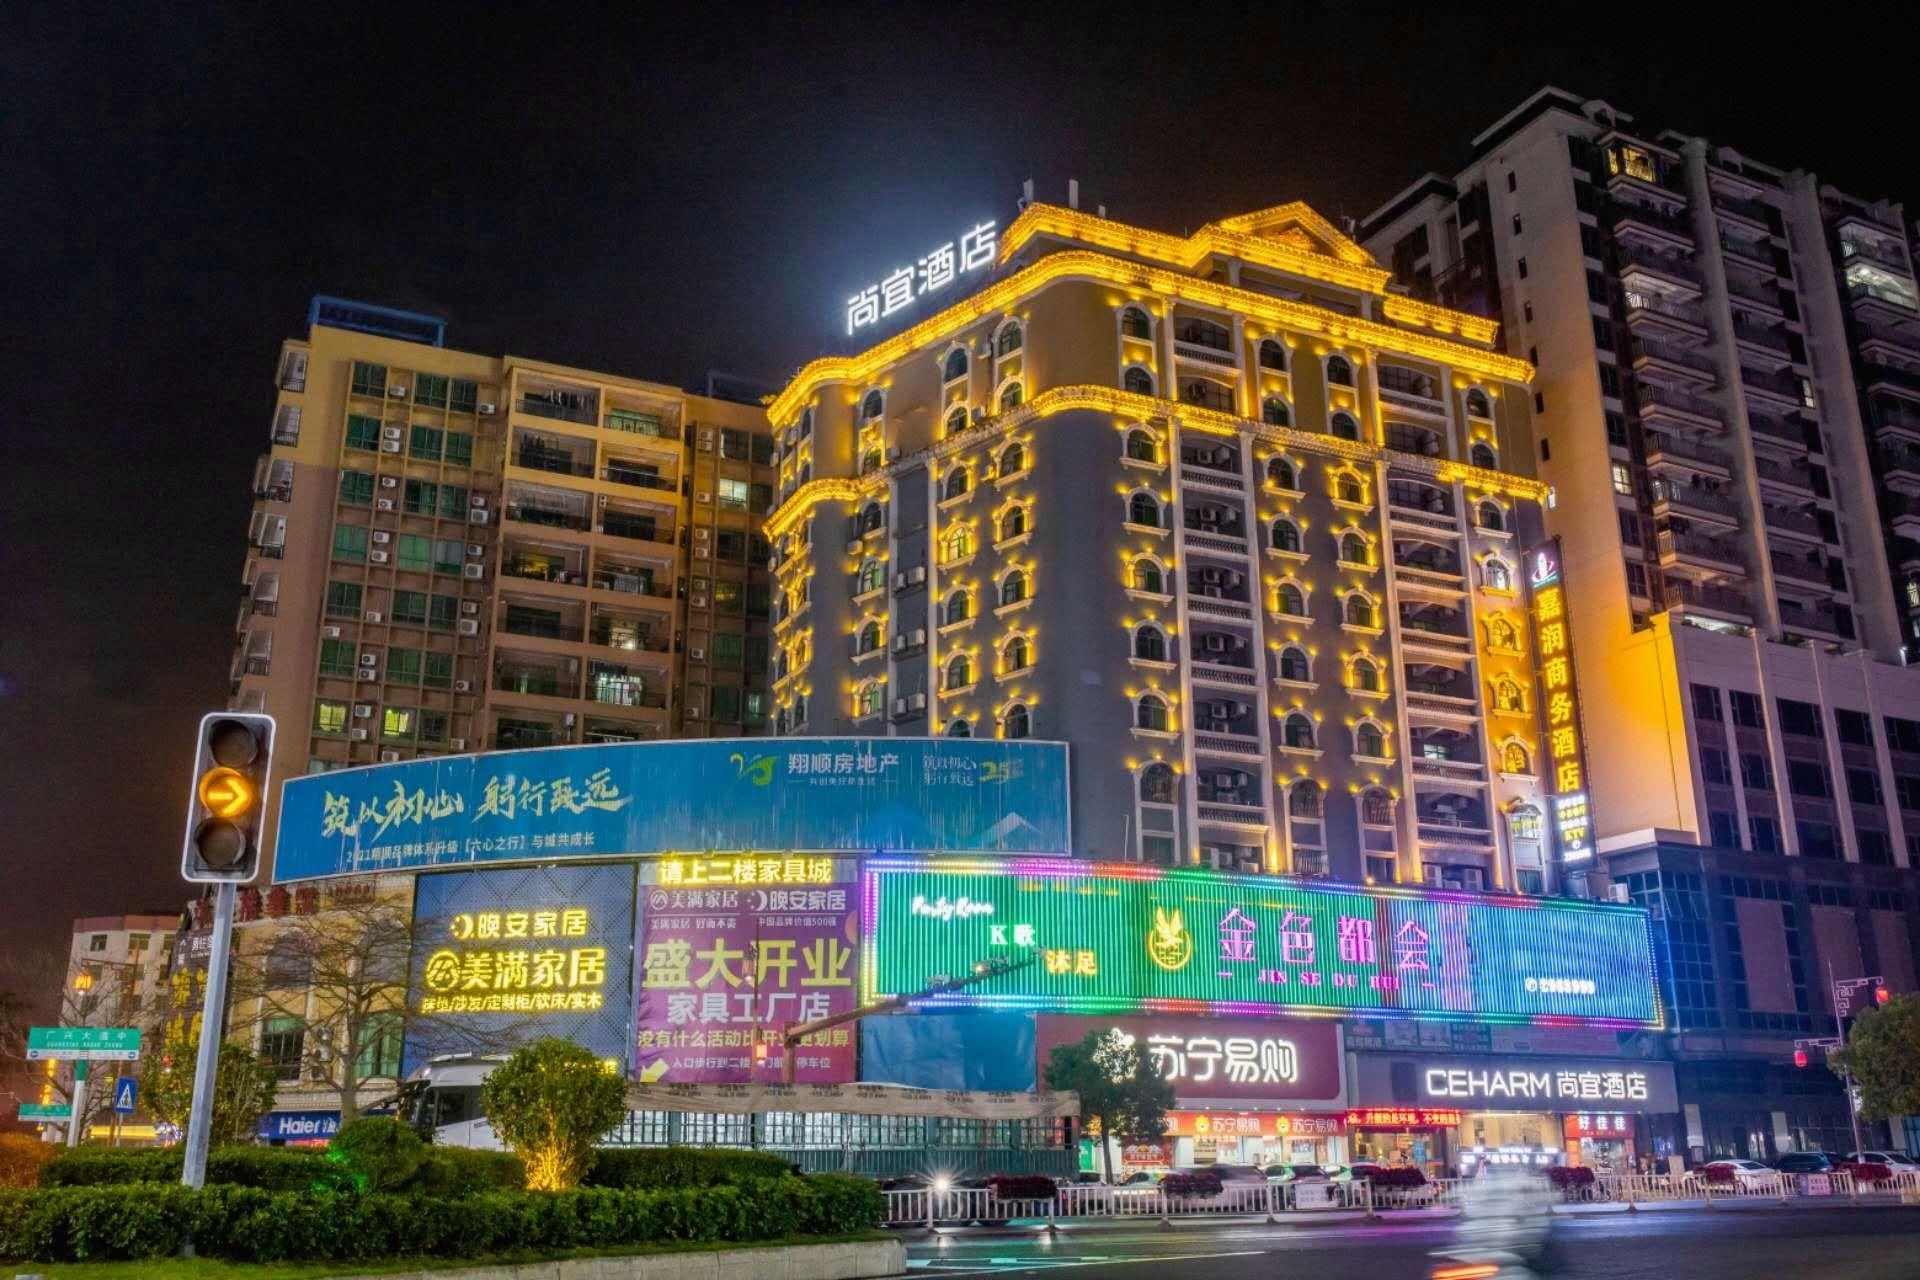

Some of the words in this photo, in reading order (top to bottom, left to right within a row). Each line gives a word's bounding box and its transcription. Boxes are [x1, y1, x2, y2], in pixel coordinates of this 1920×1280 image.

[847, 220, 996, 336] 尚宜酒店
[1535, 586, 1582, 794] 嘉润商务酒店
[787, 751, 900, 775] 翔顺房地产
[472, 767, 634, 825] 躬行致远
[659, 857, 833, 886] 请上二楼家具城
[670, 889, 739, 910] 美满家居
[769, 889, 847, 912] 晚安家居
[476, 909, 588, 940] 晚安家居
[1217, 907, 1430, 972] 金色都会
[460, 948, 607, 990] 美满家居
[640, 938, 852, 989] 盛大开业
[1045, 948, 1099, 976] 沐足
[1258, 969, 1287, 985] JIN
[1301, 971, 1322, 986] SE
[1333, 973, 1357, 988] DU
[1370, 975, 1399, 990] HUI
[666, 991, 831, 1025] 家具工厂店
[1147, 1033, 1299, 1084] 苏宁易购
[1425, 1068, 1551, 1098] CEHARM
[1556, 1070, 1649, 1100] 尚宜酒店
[279, 1116, 321, 1134] Haier
